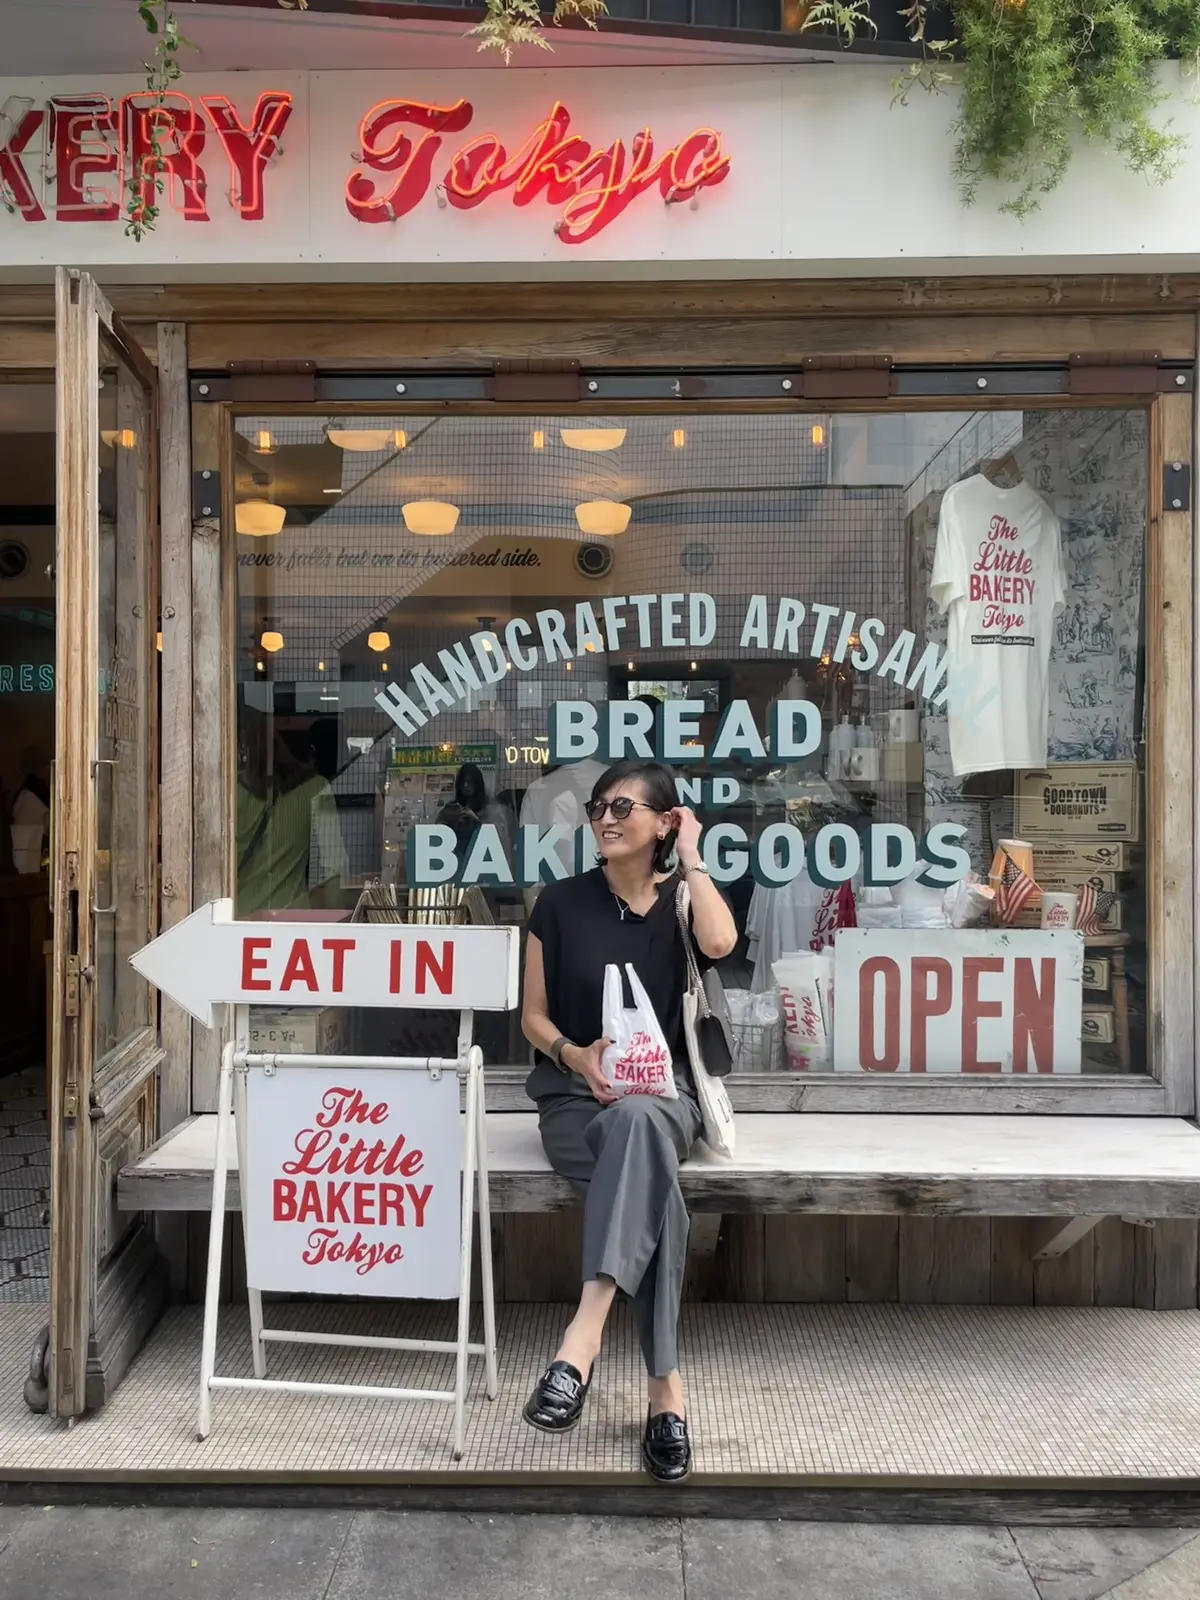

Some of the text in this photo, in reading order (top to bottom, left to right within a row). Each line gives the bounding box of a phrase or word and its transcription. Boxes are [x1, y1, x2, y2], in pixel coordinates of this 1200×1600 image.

[344, 98, 732, 246] Tokyo
[988, 515, 1018, 541] The
[501, 547, 541, 567] side.
[973, 541, 1033, 575] Little
[969, 574, 1035, 604] BAKERY
[374, 592, 717, 737] HANDCRAFTED
[551, 700, 822, 763] BREAD
[675, 777, 742, 808] ND
[702, 822, 972, 887] GOODS
[241, 937, 454, 995] EAT IN
[858, 956, 1056, 1074] OPEN
[315, 1086, 390, 1128] The
[282, 1129, 425, 1178] Little
[273, 1178, 434, 1228] BAKERY
[302, 1228, 404, 1276] Tokyo
